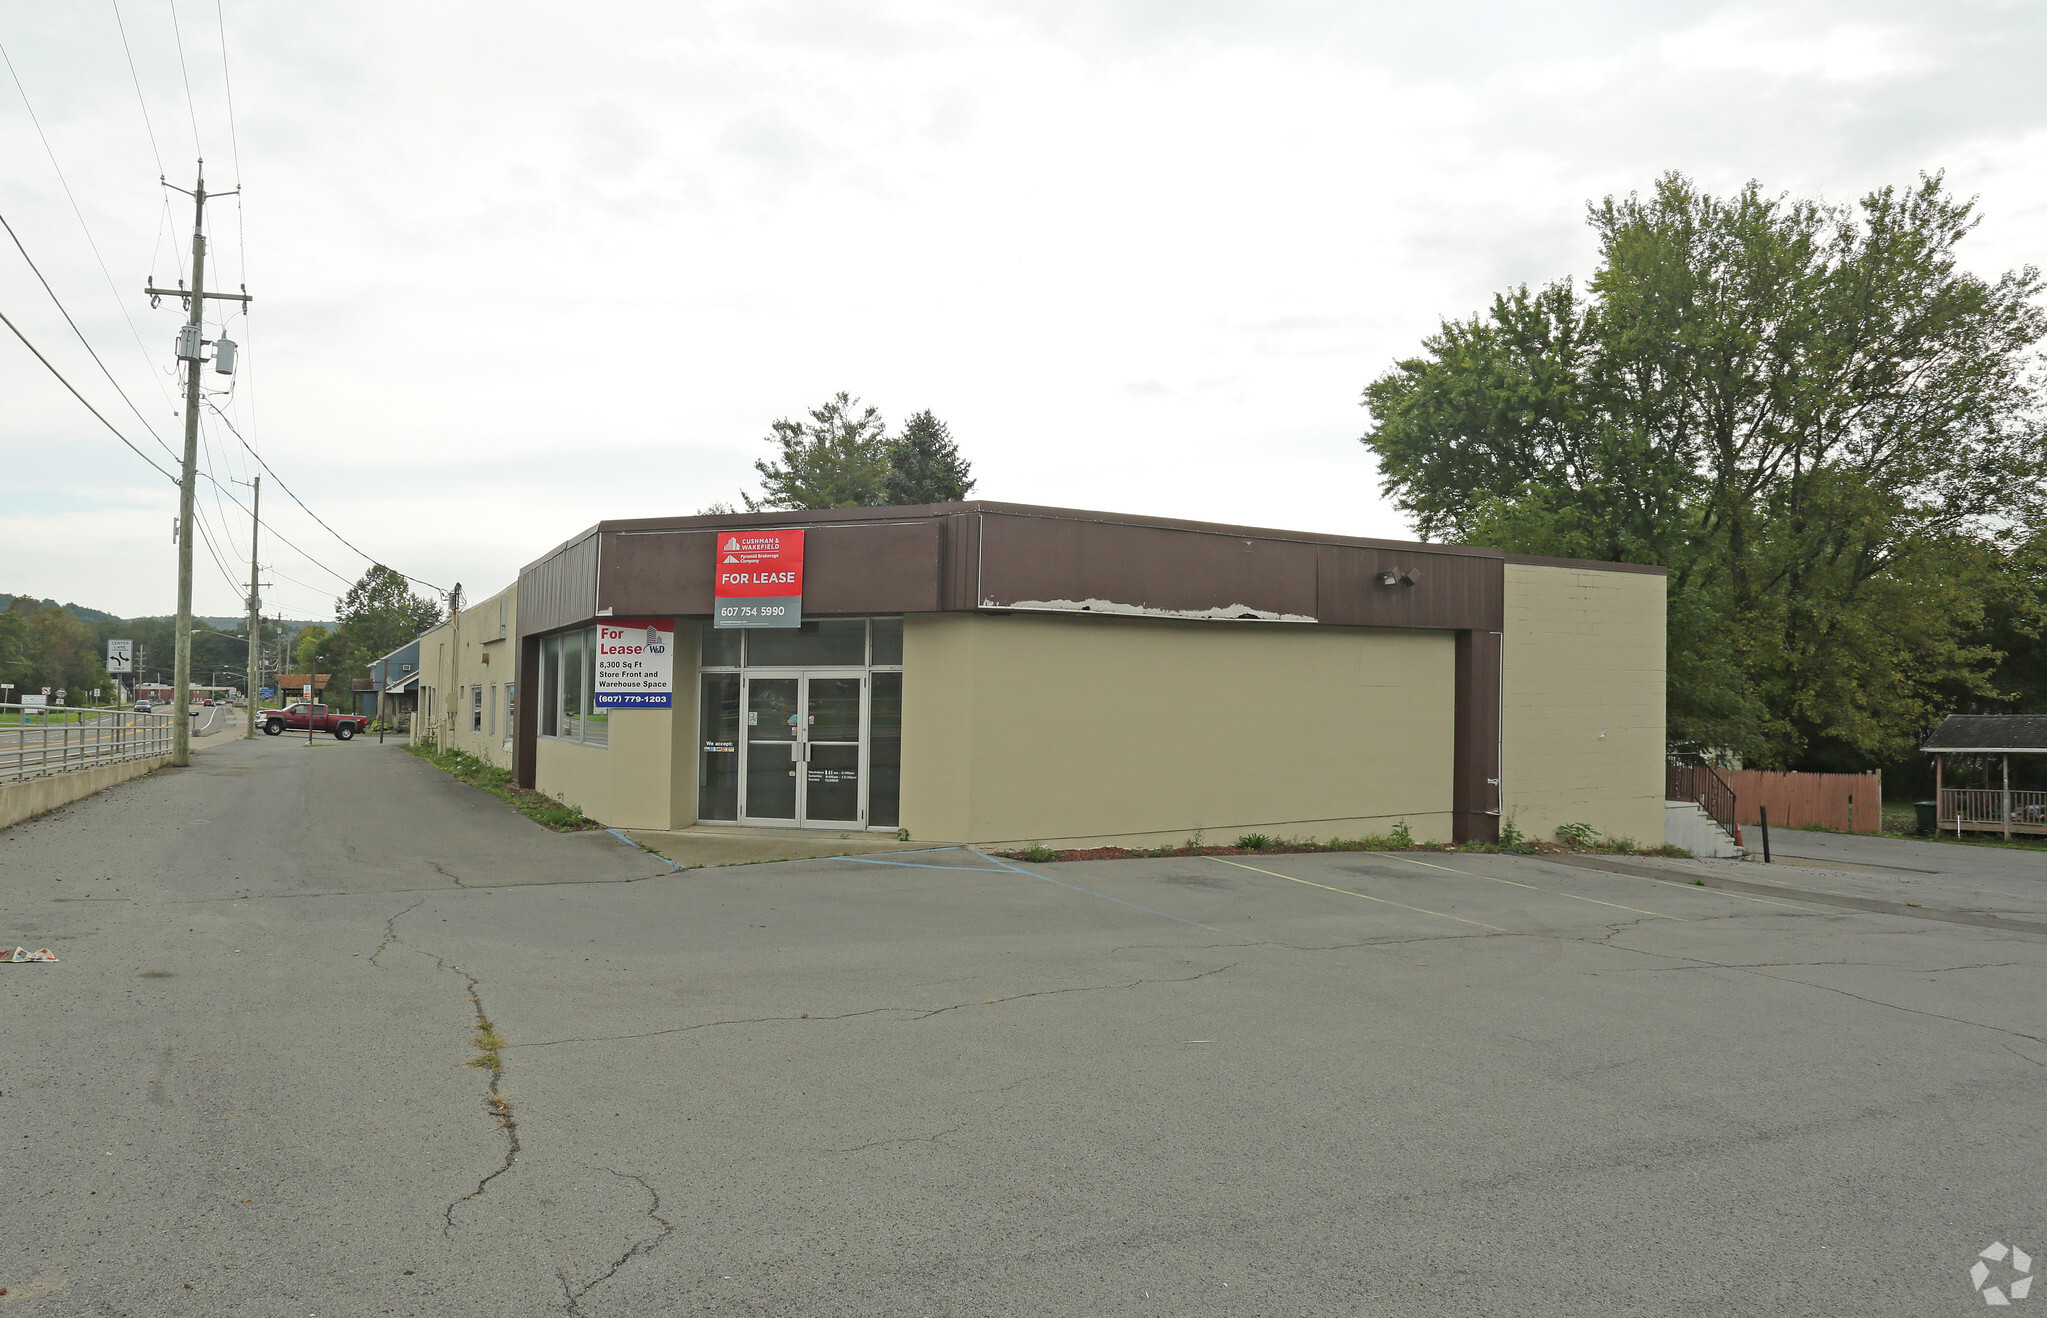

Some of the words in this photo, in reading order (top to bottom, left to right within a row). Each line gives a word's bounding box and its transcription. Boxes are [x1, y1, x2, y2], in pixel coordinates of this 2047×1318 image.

[722, 573, 749, 584] FOR
[753, 572, 795, 584] LEASE
[721, 607, 738, 616] 607
[741, 607, 757, 616] 754
[760, 606, 784, 616] 5990
[601, 628, 624, 639] For
[600, 644, 642, 654] Lease
[650, 646, 664, 654] W&D
